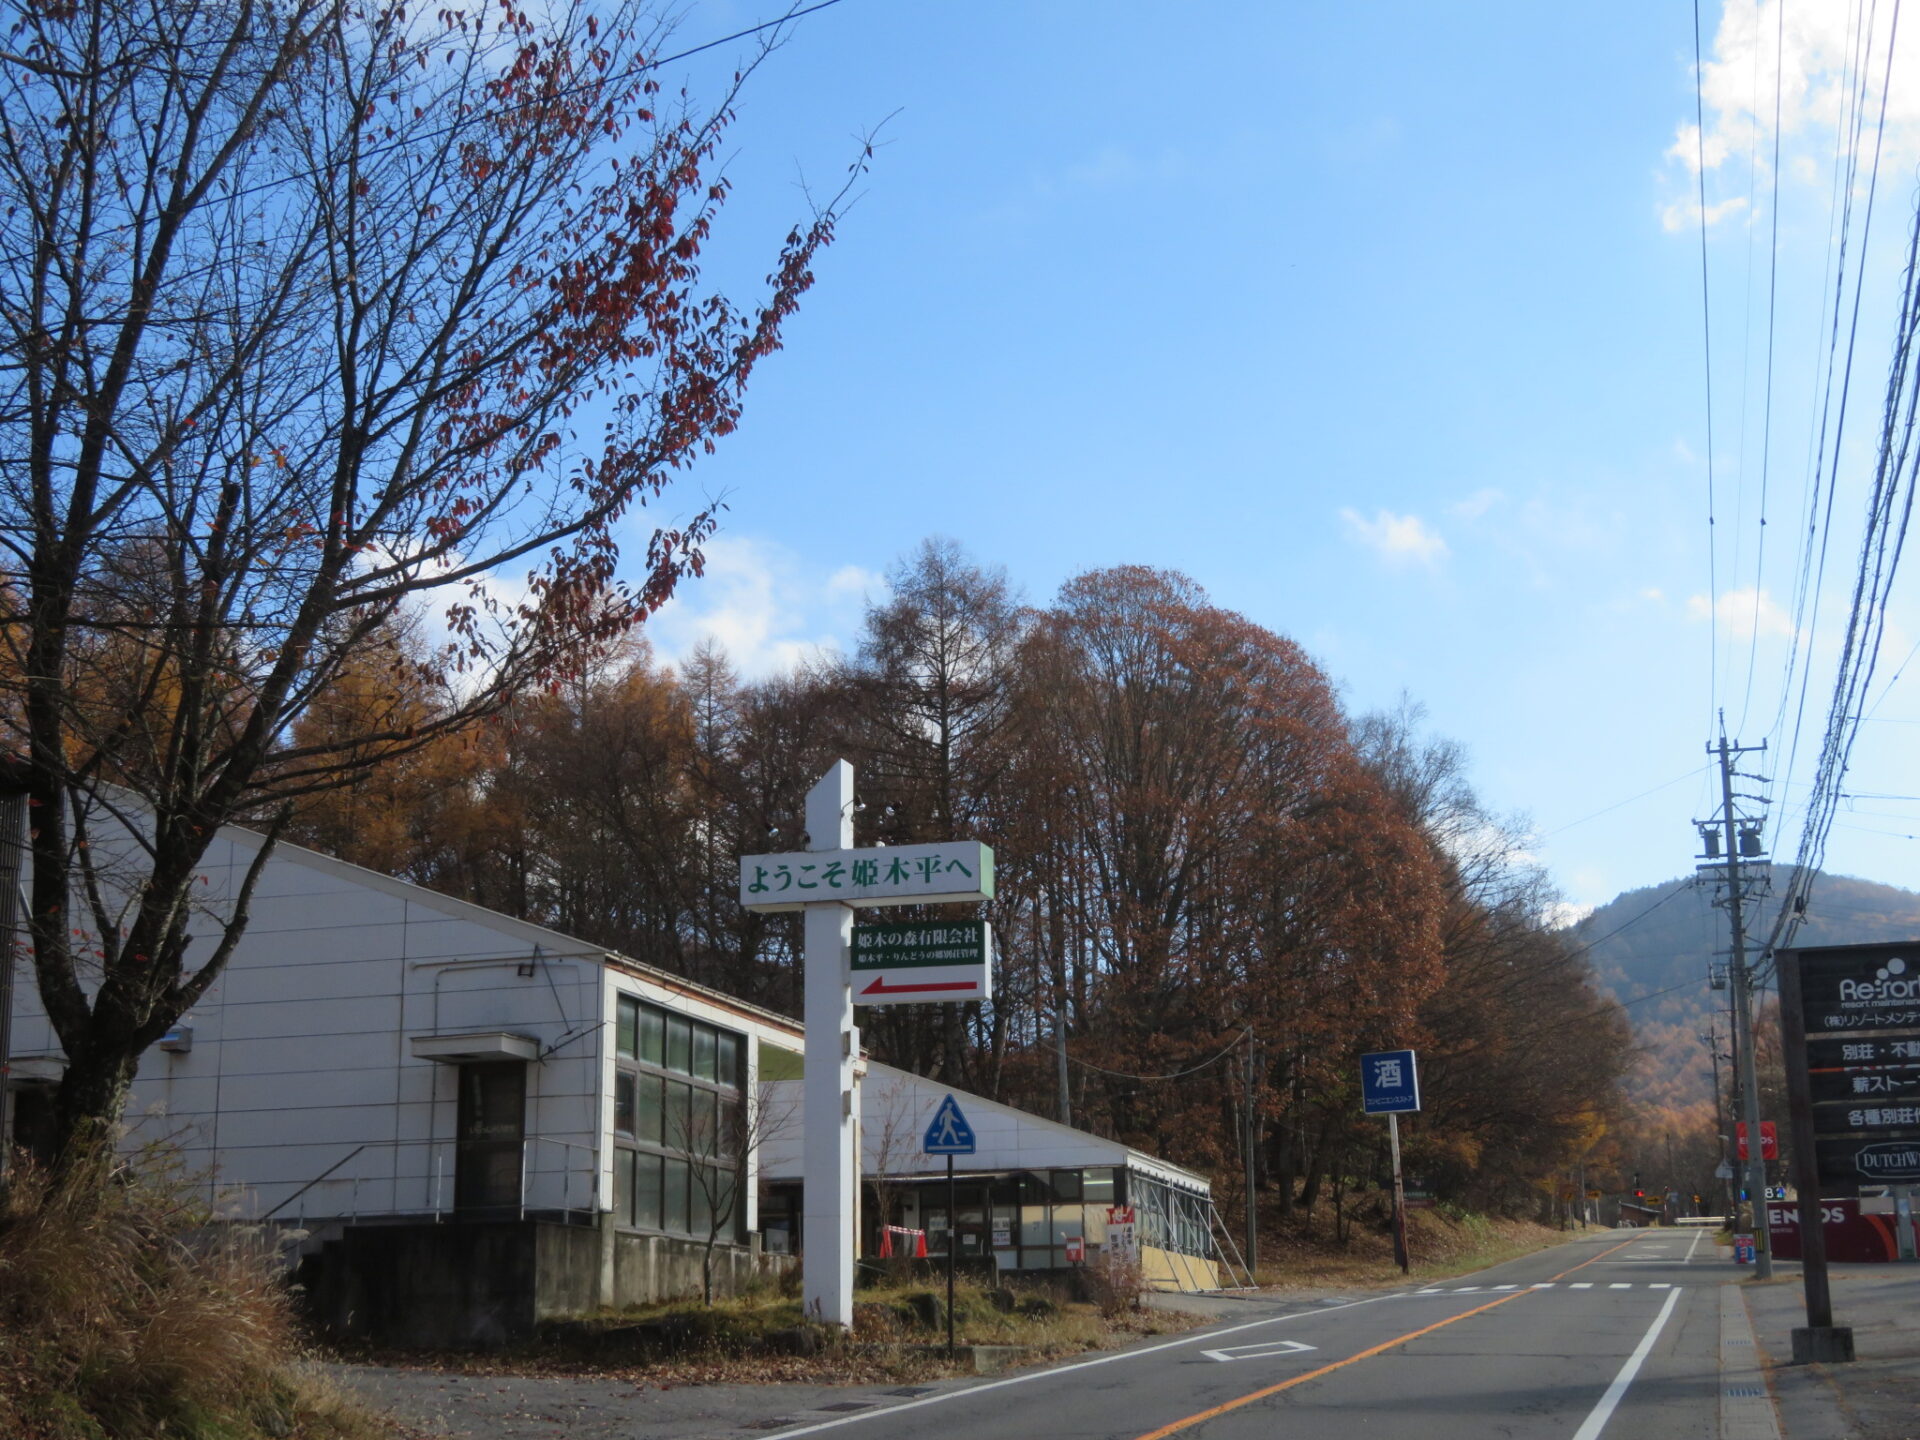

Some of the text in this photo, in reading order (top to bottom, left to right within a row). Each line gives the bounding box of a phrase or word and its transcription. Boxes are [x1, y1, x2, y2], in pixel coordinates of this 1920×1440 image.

[747, 854, 973, 893] ようこそ姫木平へ
[857, 927, 979, 949] 姫木の森有限会社
[1374, 1059, 1402, 1088] 酒
[1852, 1074, 1920, 1093] 薪ストー
[1863, 1151, 1920, 1168] DUTCHW
[1768, 1206, 1845, 1225] ENOS
